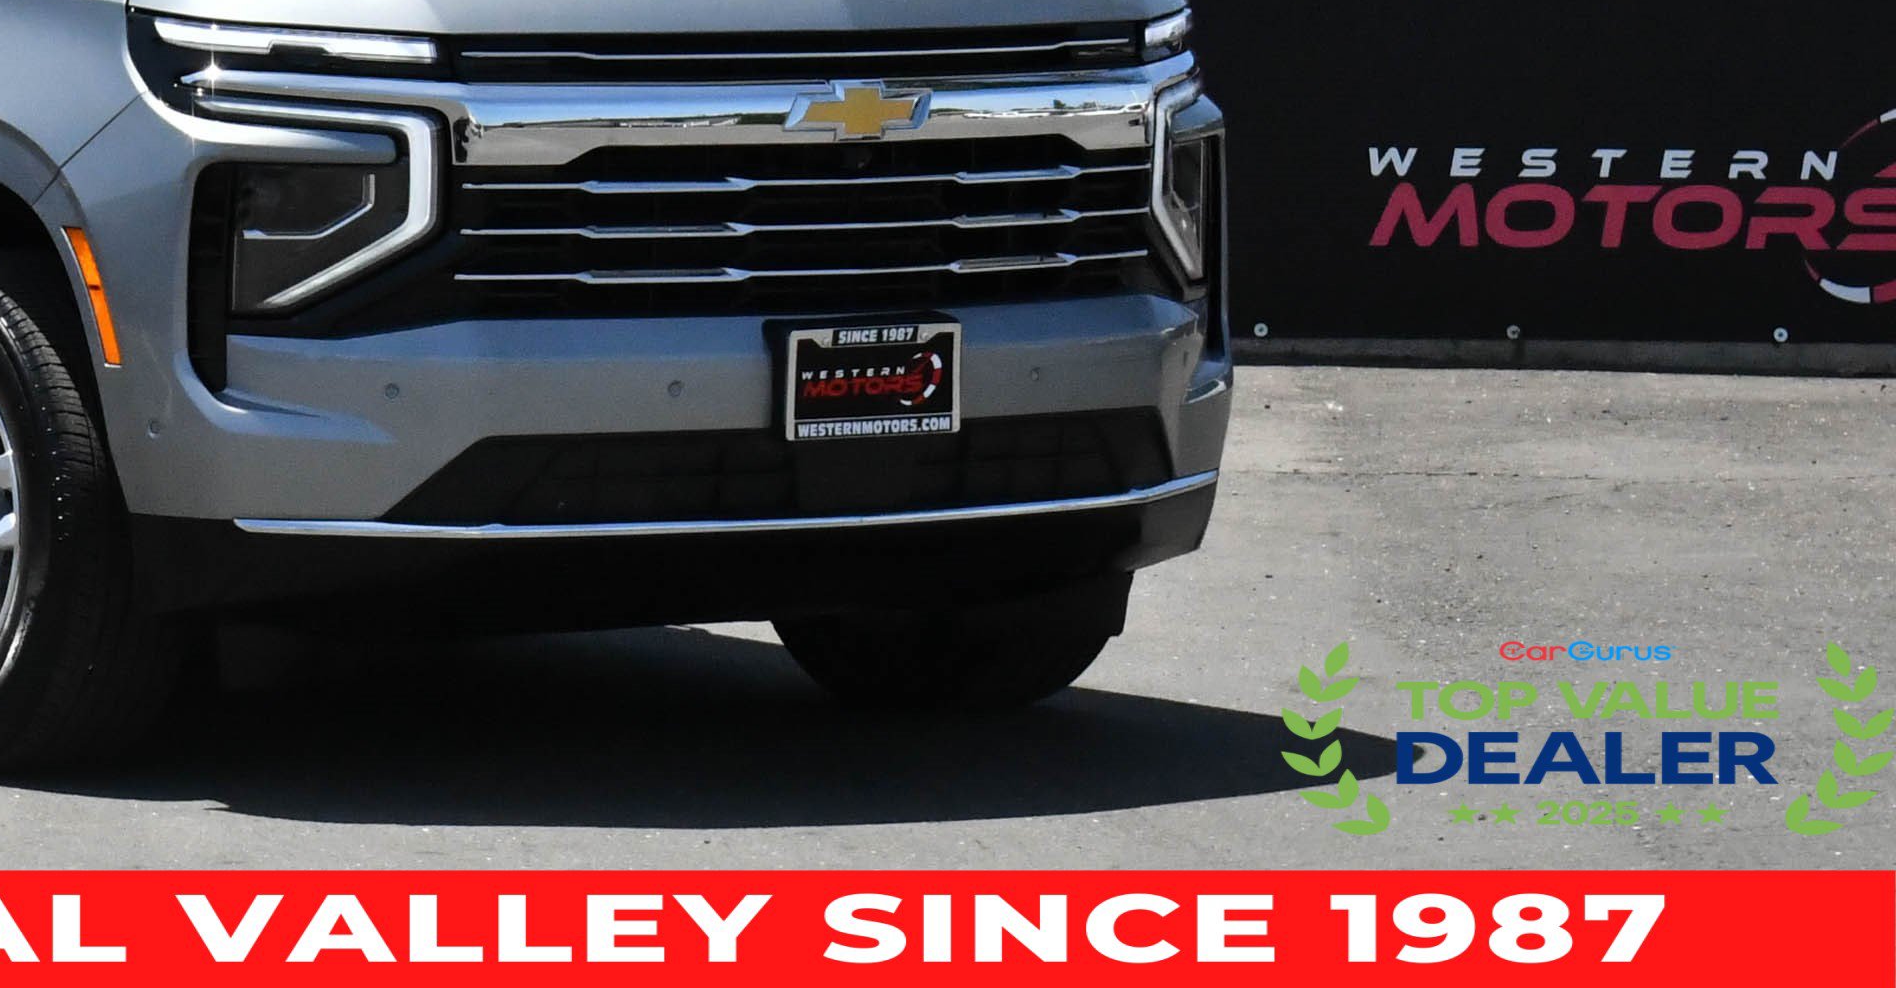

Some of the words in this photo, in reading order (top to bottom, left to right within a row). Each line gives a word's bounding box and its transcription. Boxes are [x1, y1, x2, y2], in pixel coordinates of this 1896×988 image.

[1368, 147, 1838, 180] WESTERN
[1370, 183, 1896, 252] MOTORS
[838, 329, 878, 344] SINCE
[882, 327, 914, 342] 1987
[802, 366, 905, 380] WESTERN
[803, 372, 925, 396] MOTORS
[797, 416, 951, 438] WESTERNMOTORS.COM
